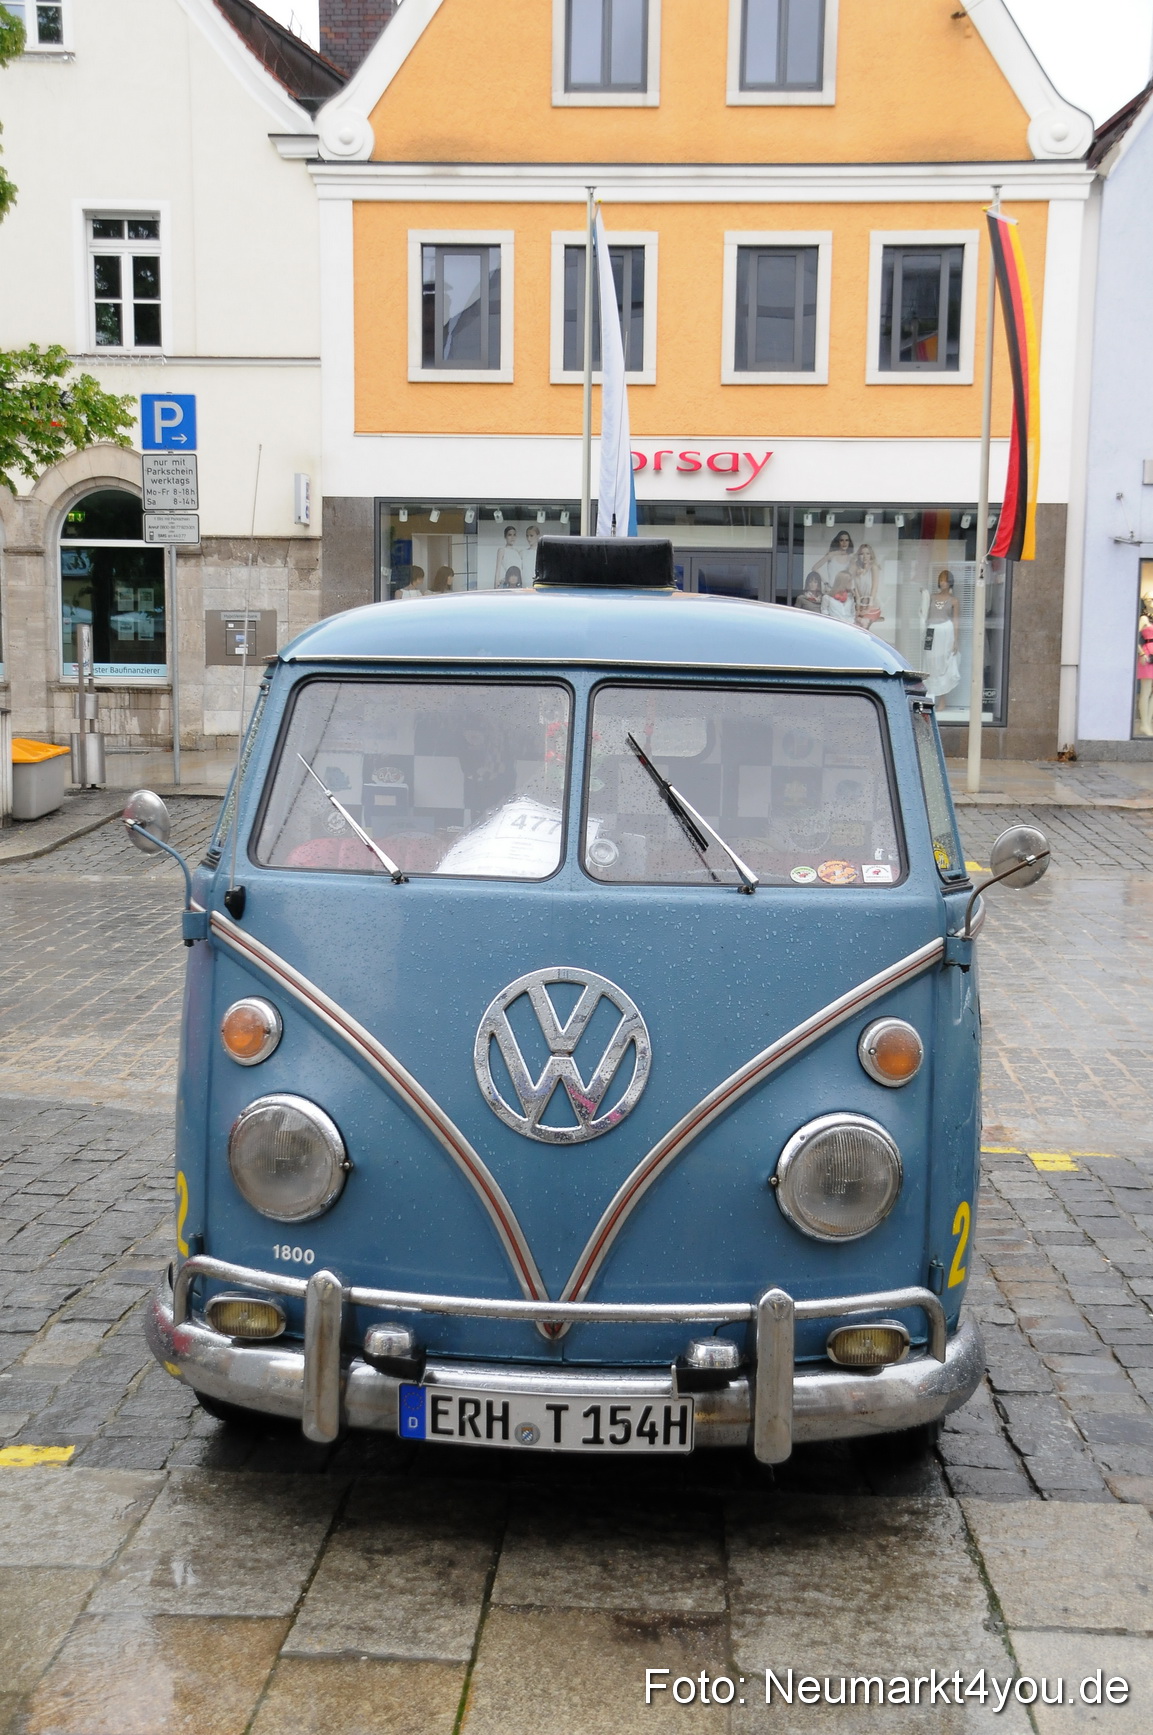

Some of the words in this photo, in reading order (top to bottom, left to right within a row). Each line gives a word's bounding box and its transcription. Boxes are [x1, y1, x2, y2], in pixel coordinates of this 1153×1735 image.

[154, 401, 184, 444] P
[172, 458, 186, 466] mit
[146, 467, 194, 476] Parkschein
[150, 477, 190, 487] werktags
[146, 488, 170, 496] Mo-Fr
[146, 498, 157, 506] Sa
[109, 666, 160, 675] Baufinanzierer
[947, 1200, 971, 1289] 2
[272, 1243, 316, 1265] 1800
[430, 1394, 510, 1440] ERH
[408, 1416, 418, 1429] D
